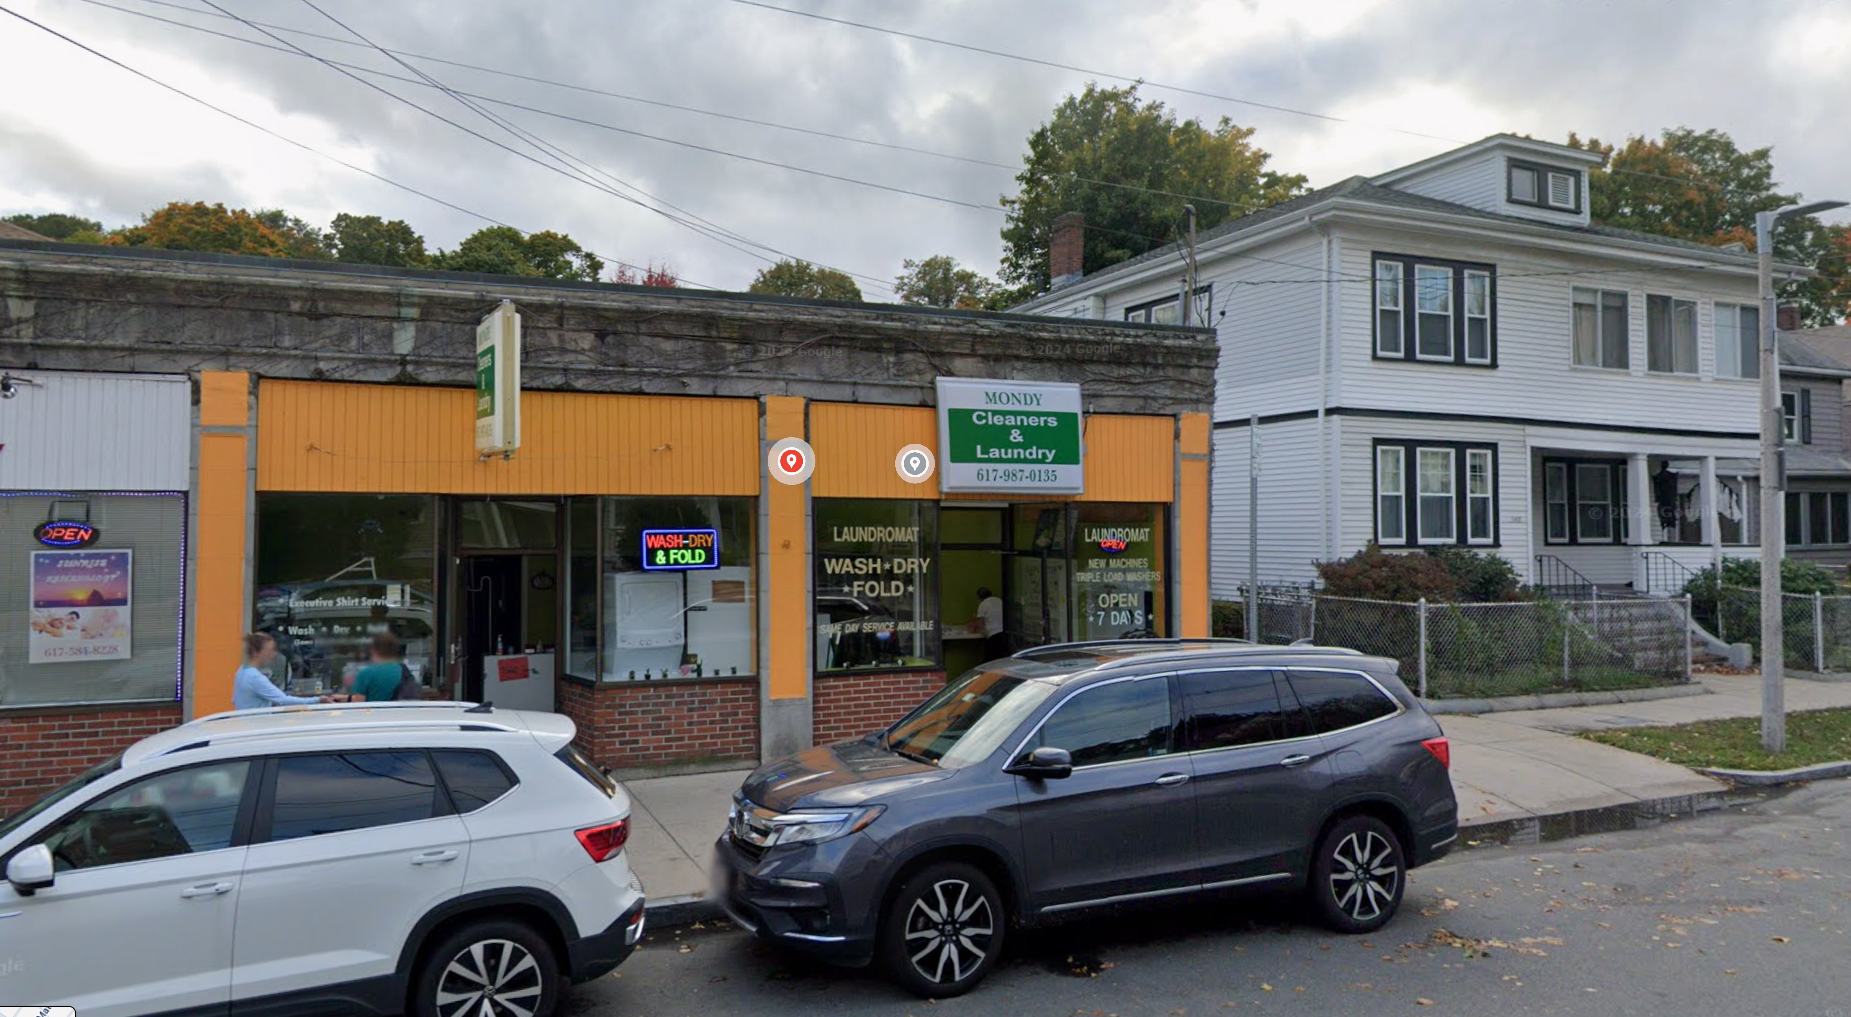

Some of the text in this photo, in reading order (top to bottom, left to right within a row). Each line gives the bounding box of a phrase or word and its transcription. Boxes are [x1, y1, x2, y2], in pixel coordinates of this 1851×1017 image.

[984, 391, 1043, 406] MONDY
[972, 411, 1058, 427] Cleaners
[1009, 429, 1024, 442] &
[976, 445, 1056, 462] Laundry
[976, 468, 1058, 483] 617-987-0135
[39, 528, 93, 541] OPEN
[833, 526, 920, 542] LAUNDROMAT
[1084, 527, 1151, 543] LAUNDROMAT
[1100, 539, 1127, 550] OPEN
[655, 549, 706, 564] & FOLD
[1088, 557, 1149, 569] NEW MACHINES
[824, 557, 931, 574] WASH DRY
[1076, 570, 1161, 583] TRIPLE LOAD WASHERS
[852, 580, 905, 597] FOLD
[288, 597, 334, 608] Executive
[336, 596, 359, 607] Shirt
[1098, 593, 1138, 608] OPEN
[1097, 611, 1105, 626] 7
[287, 625, 316, 636] Wash
[819, 620, 934, 635] SAME DAY SERVICE AVAILABLE
